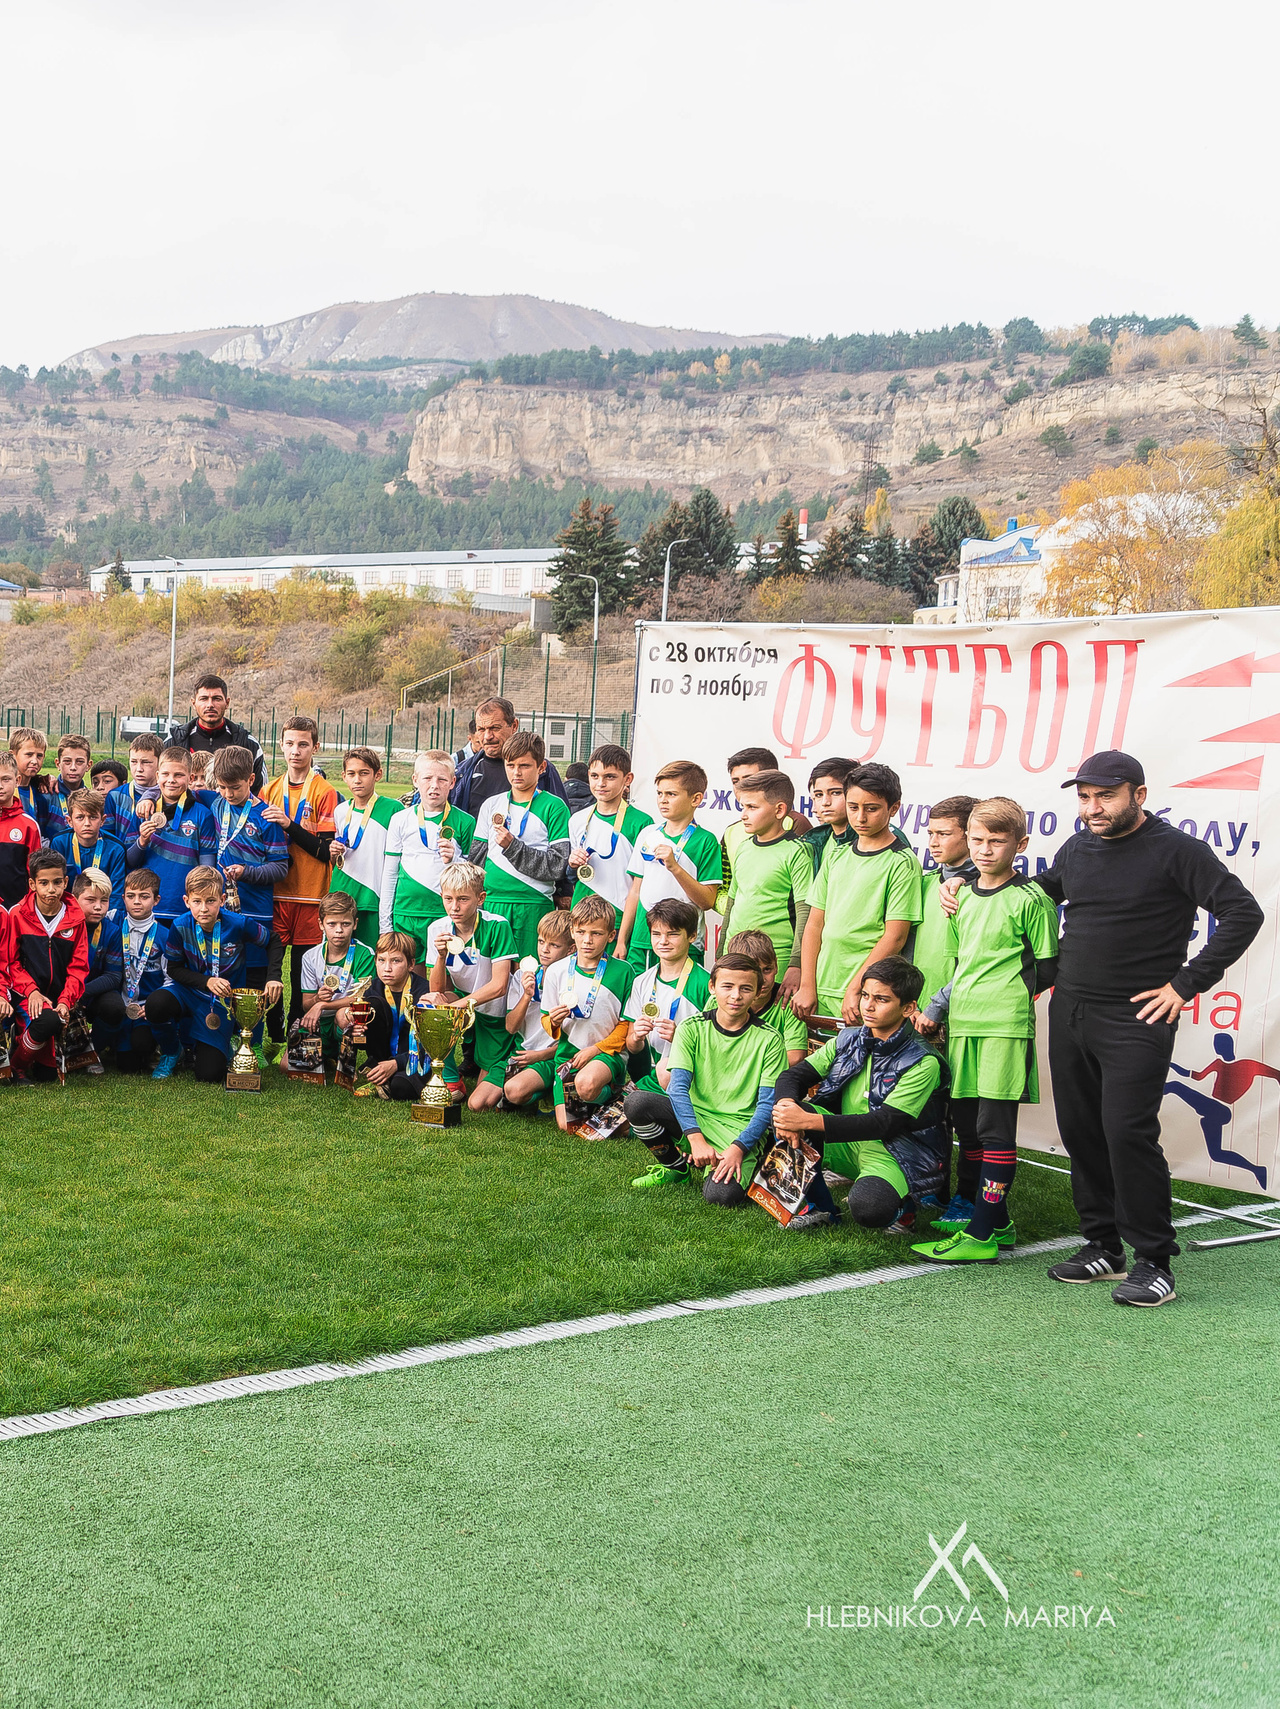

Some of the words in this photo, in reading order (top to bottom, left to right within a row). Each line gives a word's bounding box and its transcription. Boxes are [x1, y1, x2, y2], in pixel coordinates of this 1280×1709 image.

[649, 646, 660, 661] с
[665, 642, 688, 663] 28
[694, 641, 778, 668] октября
[650, 678, 674, 694] по
[679, 674, 692, 695] 3
[697, 673, 768, 701] ноября
[772, 639, 1145, 774] ФУТБОЛ
